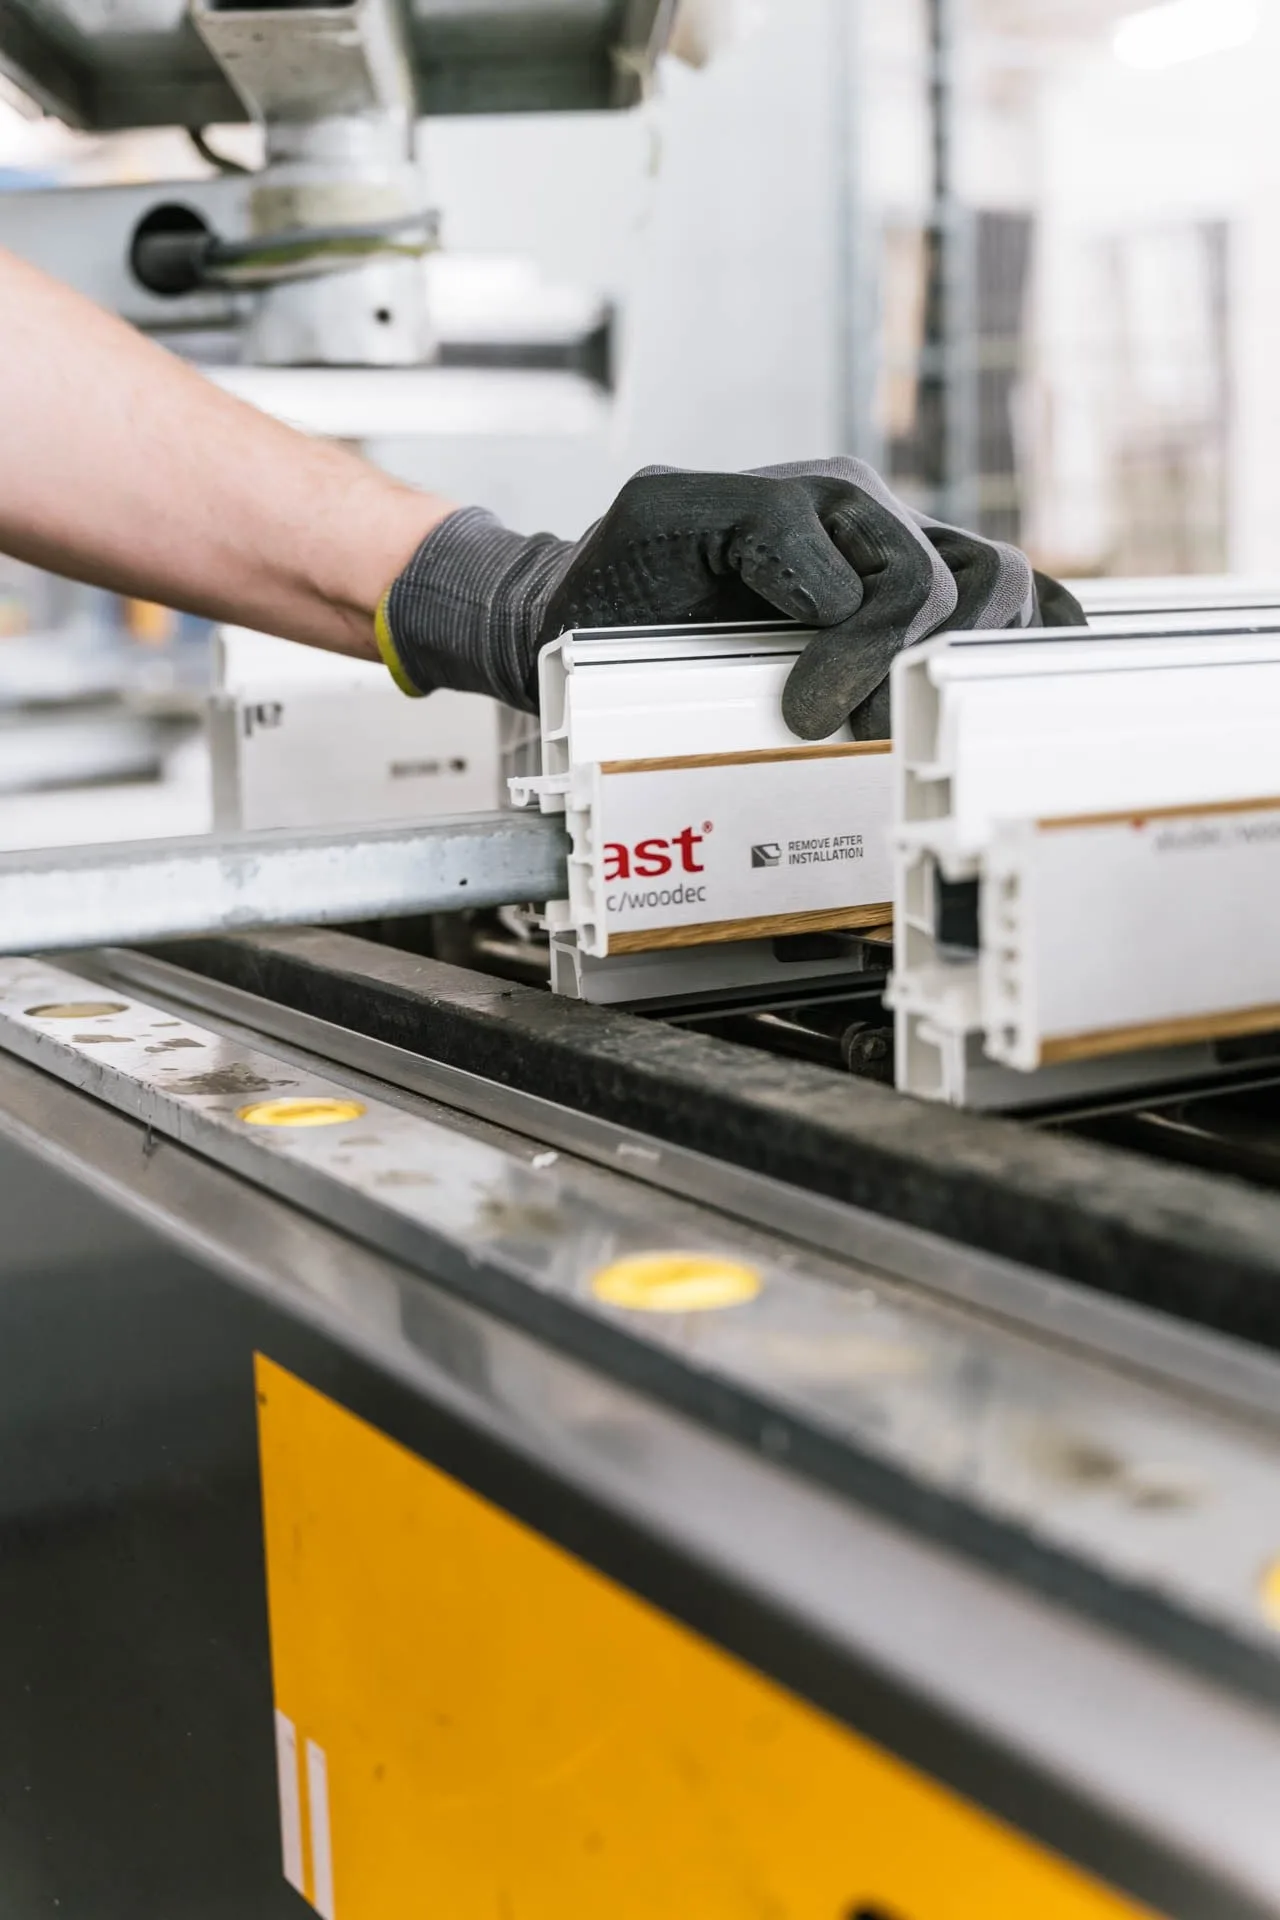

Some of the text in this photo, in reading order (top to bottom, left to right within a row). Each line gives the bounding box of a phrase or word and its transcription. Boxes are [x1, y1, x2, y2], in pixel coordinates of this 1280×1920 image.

[788, 835, 863, 852] REMOVE AFTER
[788, 847, 864, 865] INSTALLATION
[606, 883, 706, 913] c/woodec
